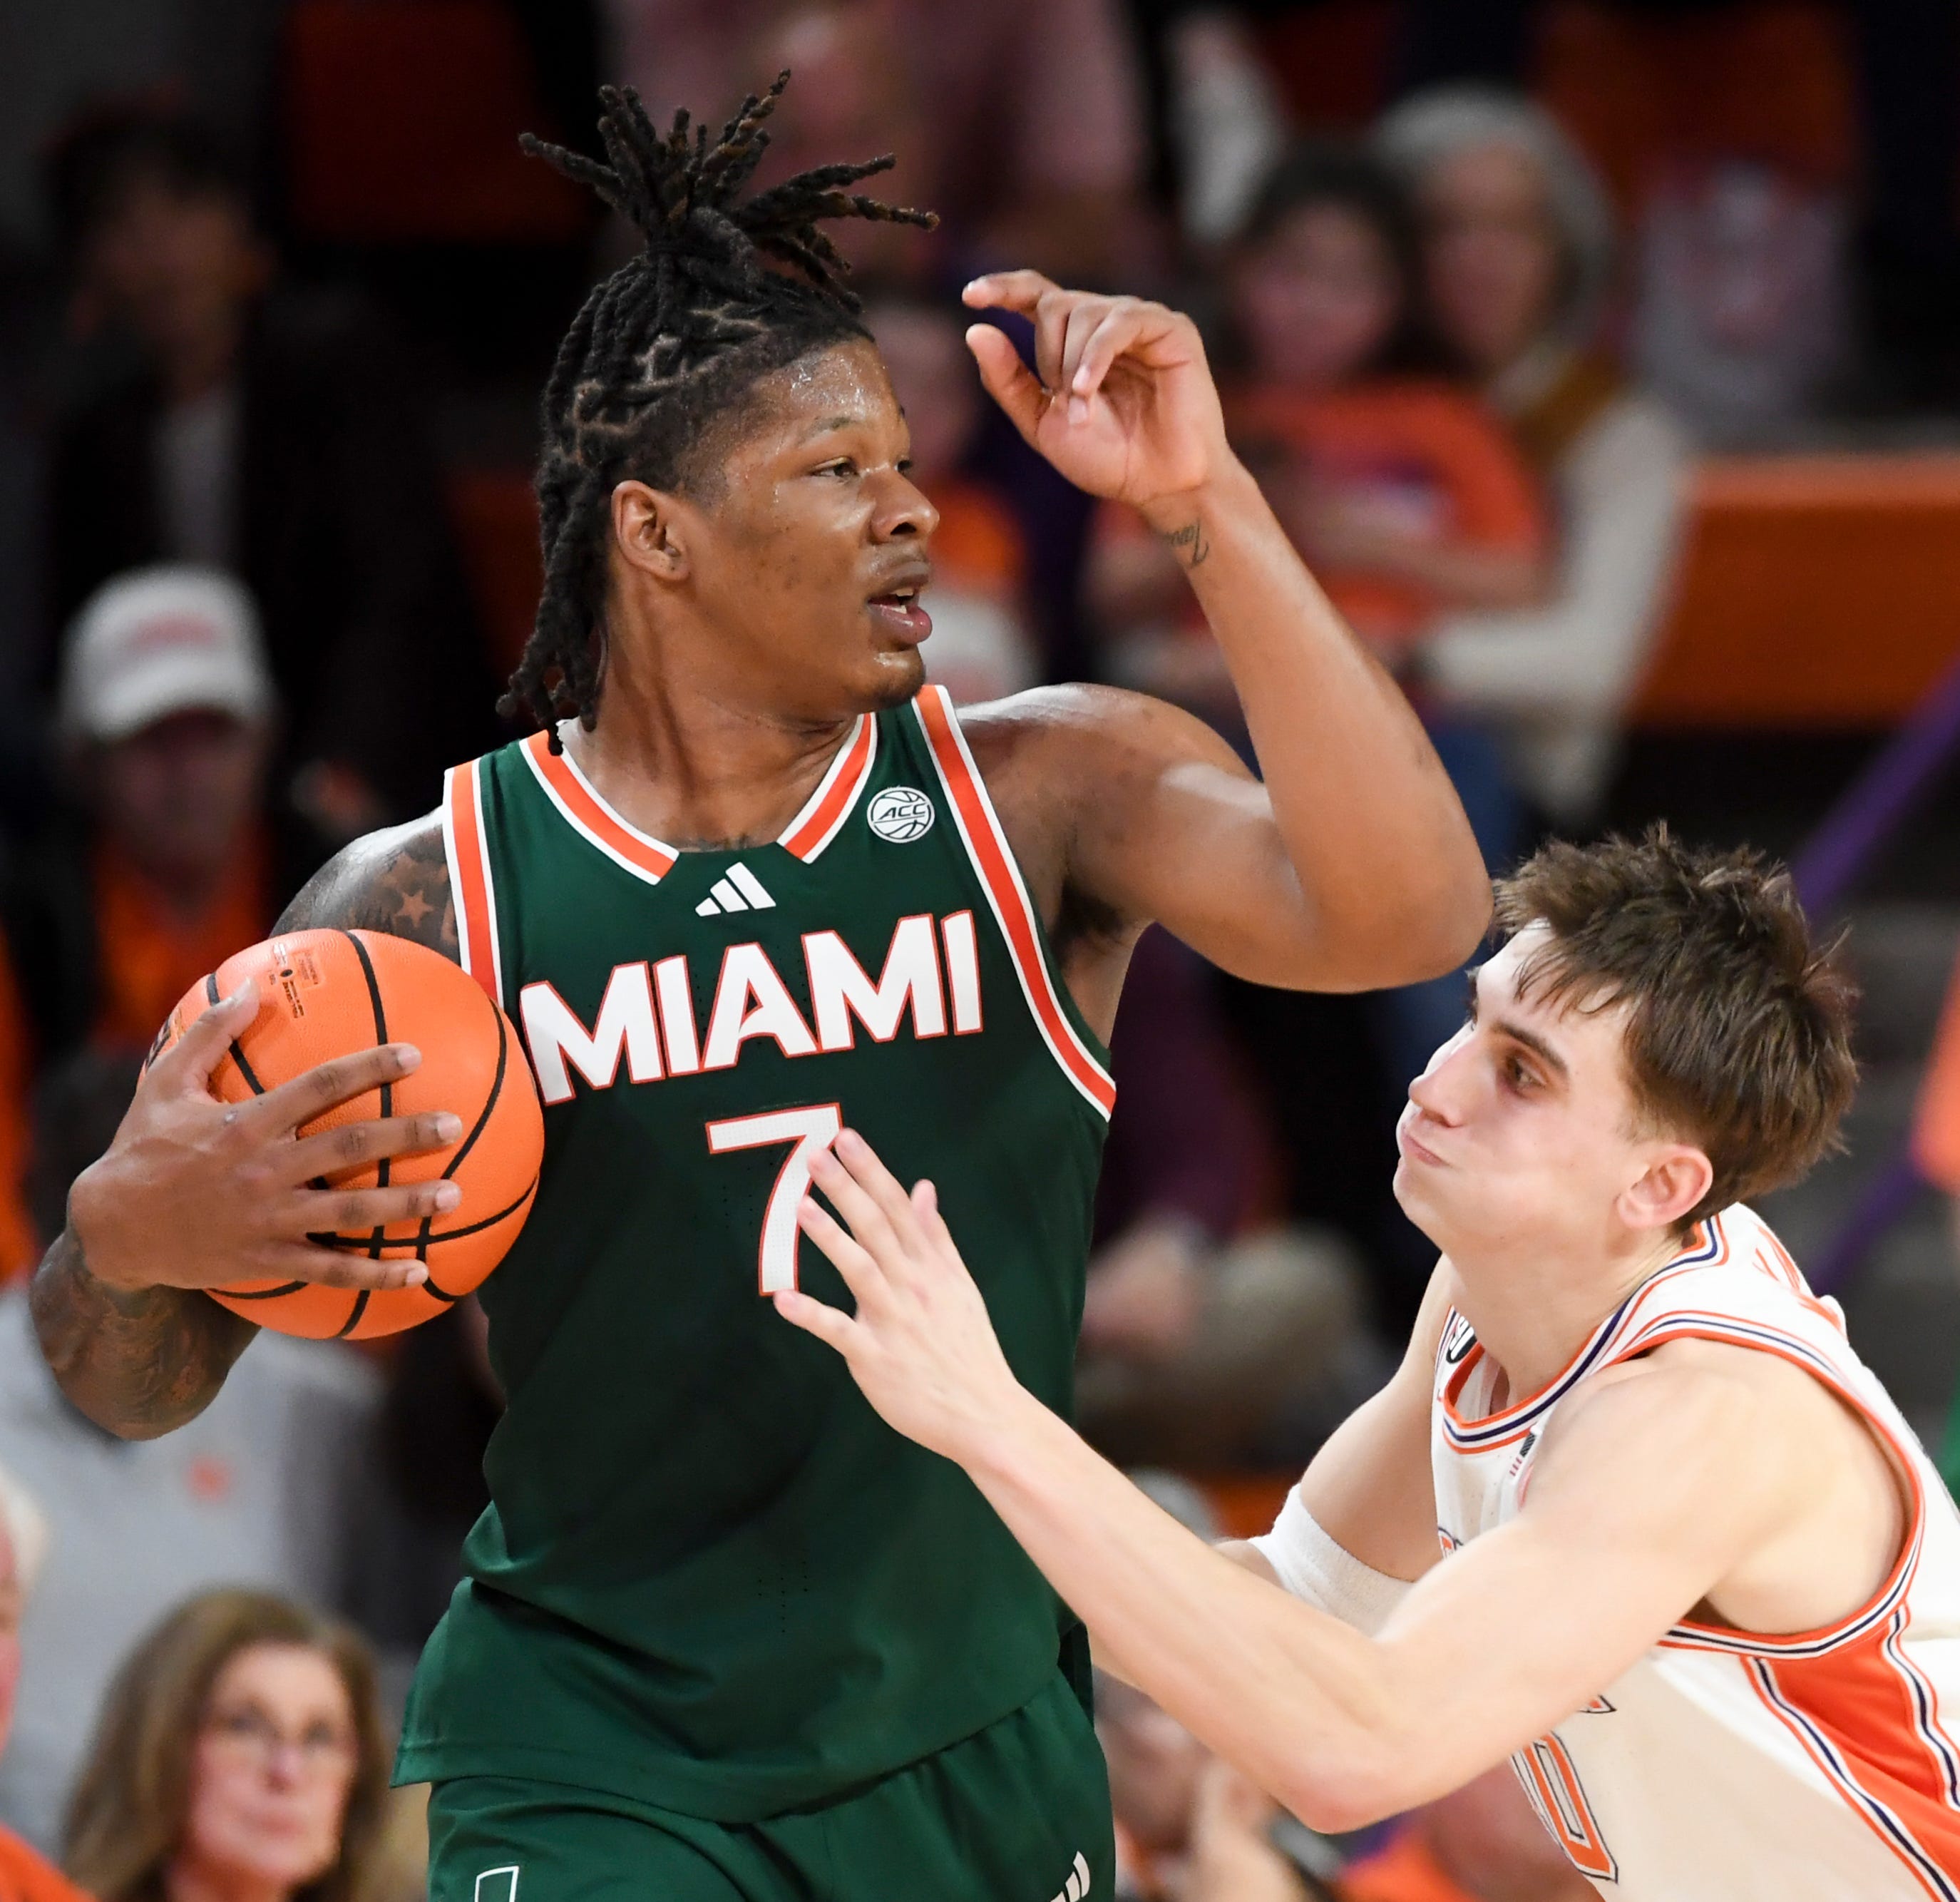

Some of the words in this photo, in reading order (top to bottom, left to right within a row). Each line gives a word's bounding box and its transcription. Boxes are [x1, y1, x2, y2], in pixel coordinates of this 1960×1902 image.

[878, 802, 927, 820] ACC
[520, 909, 983, 1106] MIAMI
[705, 1102, 843, 1297] 7
